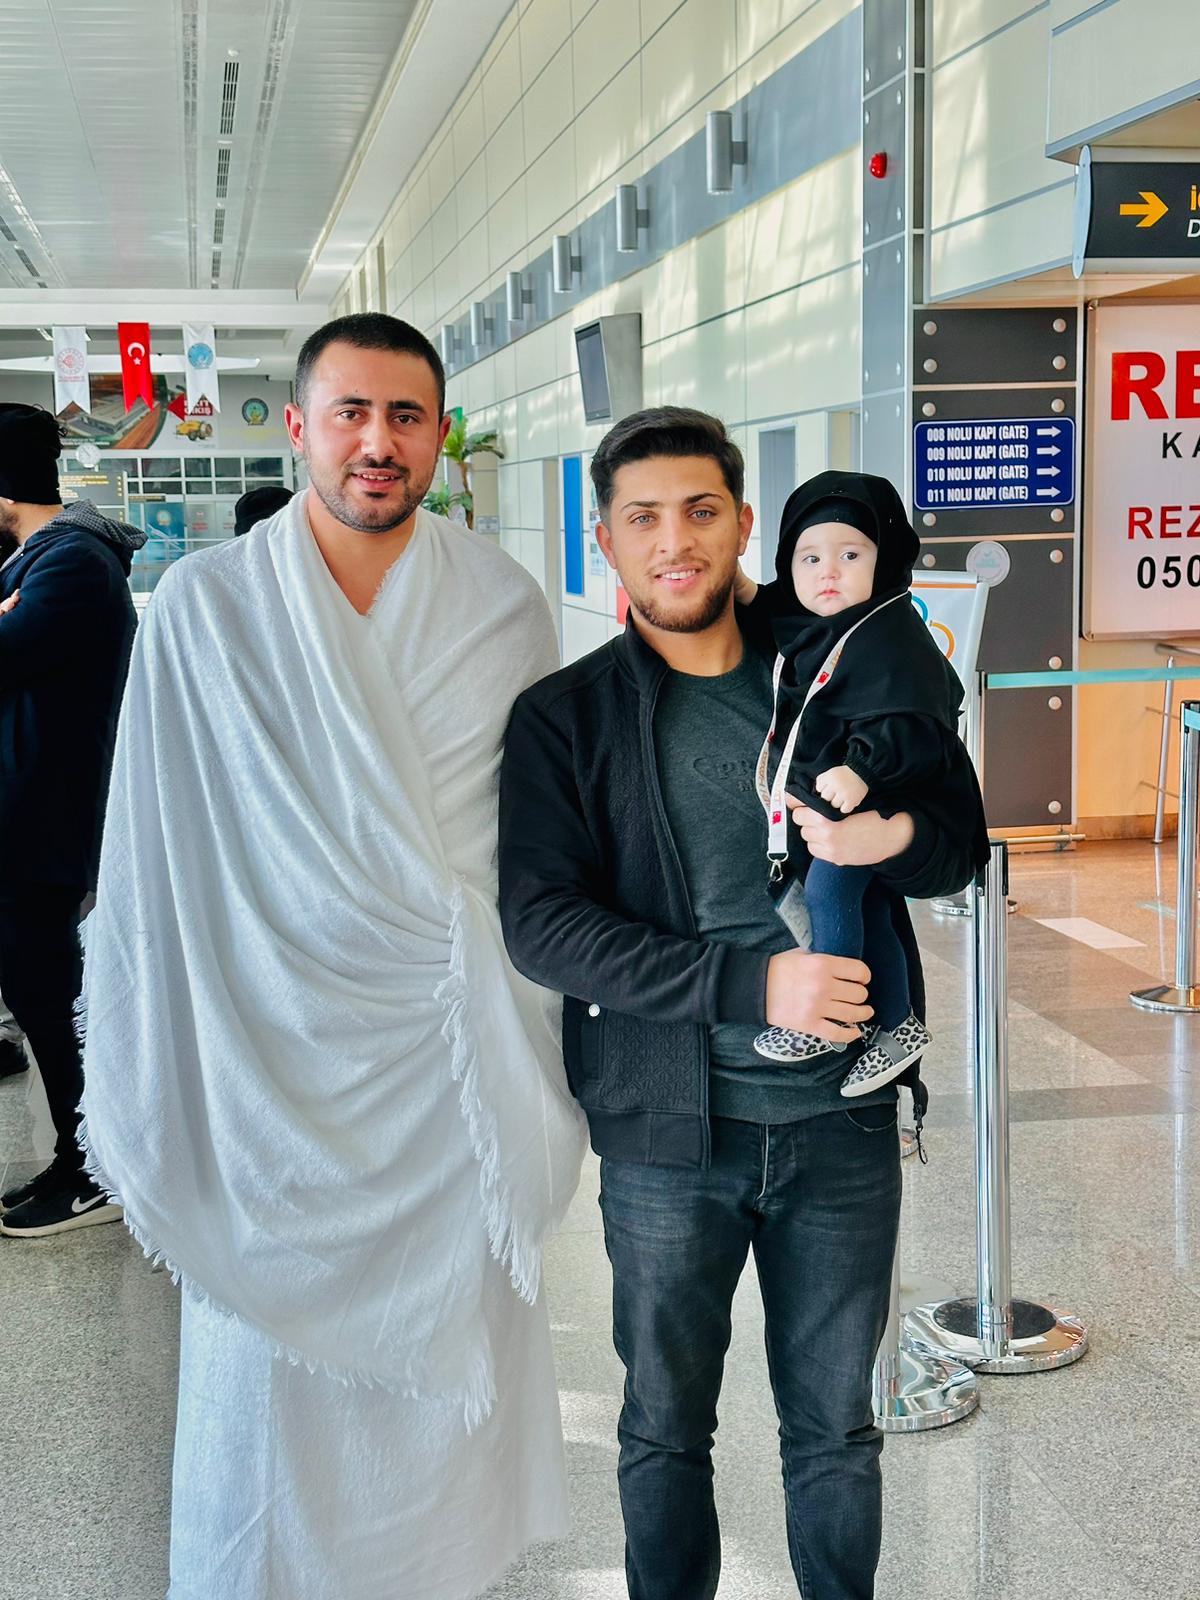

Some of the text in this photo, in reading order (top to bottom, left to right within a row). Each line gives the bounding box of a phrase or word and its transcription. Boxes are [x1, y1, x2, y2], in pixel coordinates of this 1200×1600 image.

[927, 425, 1029, 442] 008 NOLU KAPI (GATE)
[927, 444, 1029, 461] 009 NOLU KAPI (GATE)
[927, 465, 1029, 481] 010 NOLU KAPI (GATE)
[927, 486, 1029, 502] 011 NOLU KAPI (GATE)
[1137, 554, 1200, 589] 050
